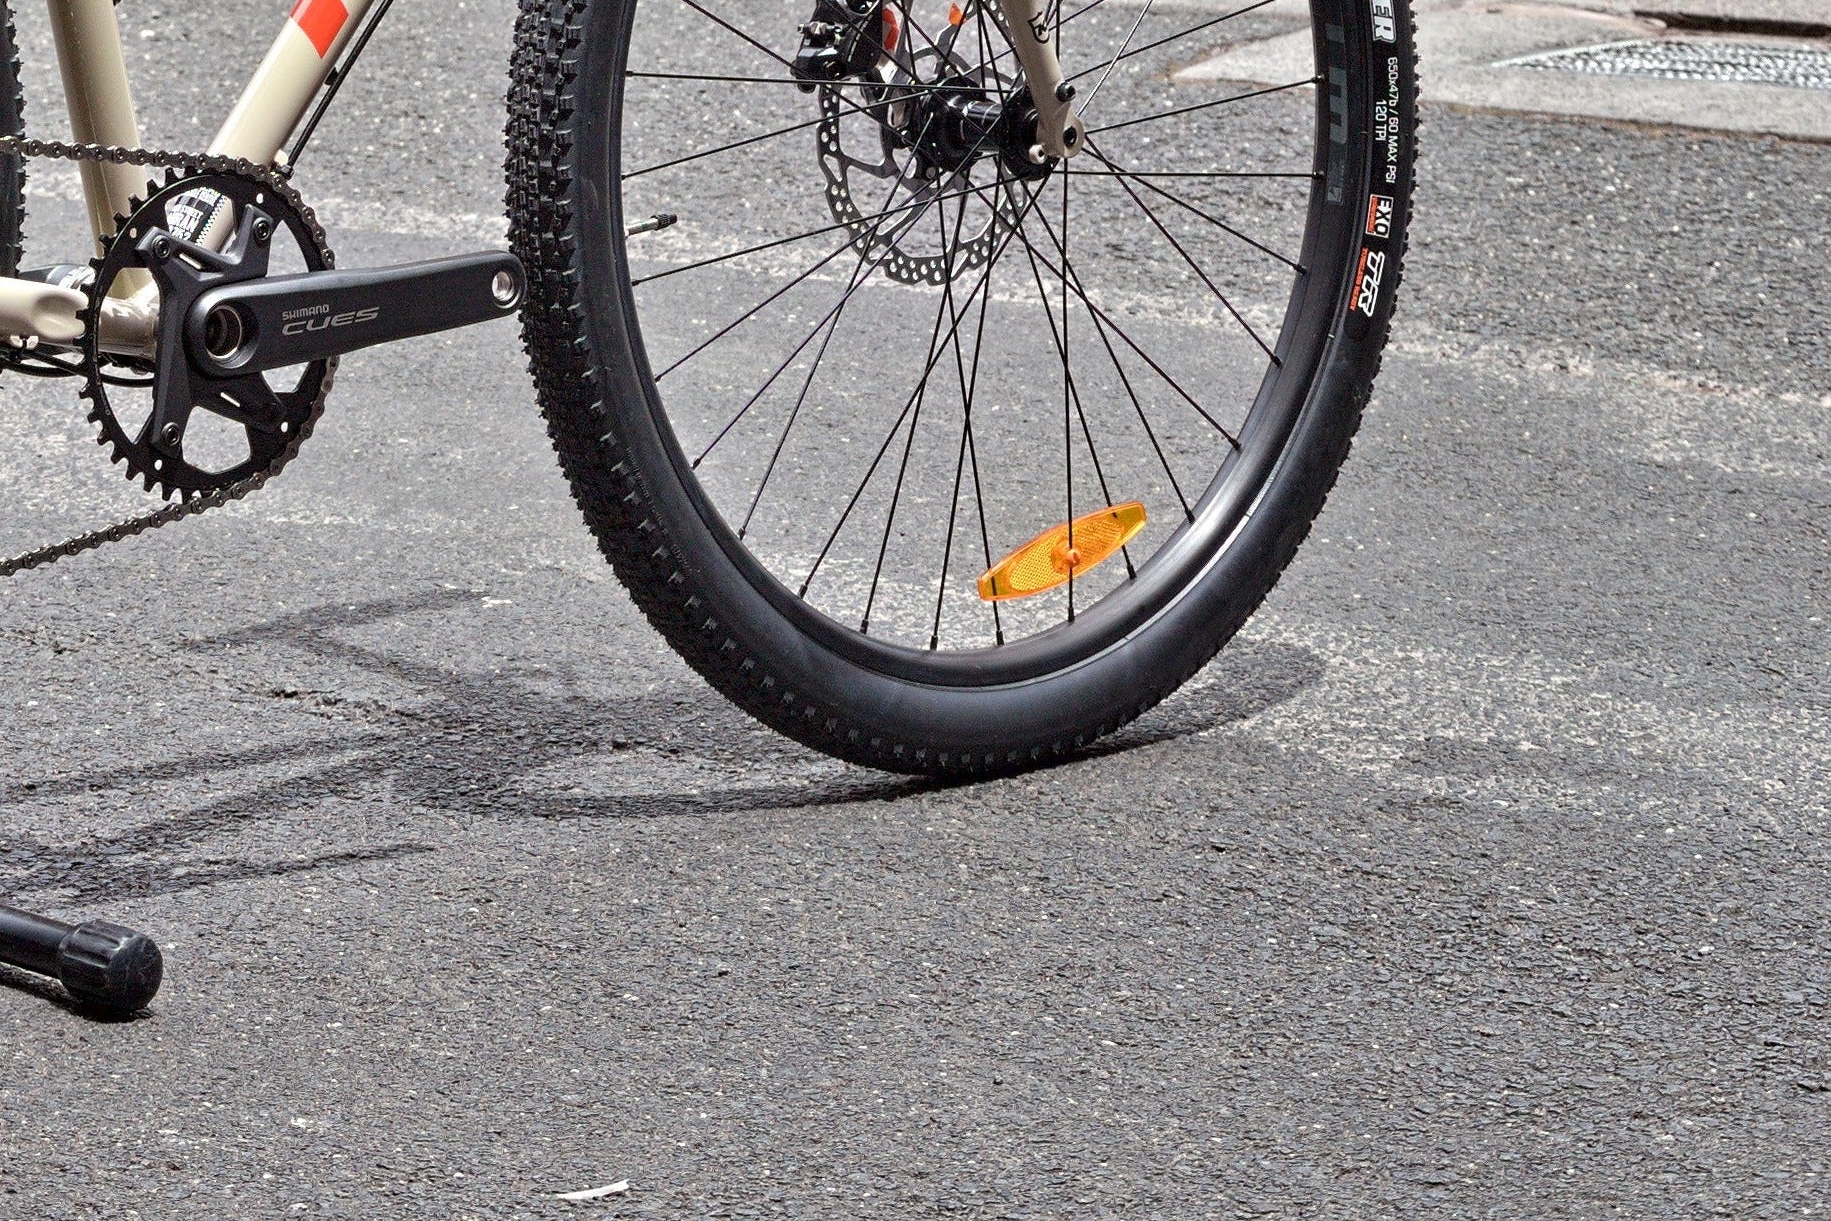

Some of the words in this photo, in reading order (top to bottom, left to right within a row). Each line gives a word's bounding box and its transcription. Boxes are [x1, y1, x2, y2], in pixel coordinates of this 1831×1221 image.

[1386, 56, 1399, 108] 650x47b
[1375, 100, 1387, 122] 120
[1375, 122, 1387, 142] TPI
[1388, 116, 1399, 133] 60
[1386, 135, 1399, 162] MAX
[1384, 162, 1399, 184] PSI
[1375, 196, 1393, 237] EXO
[1357, 250, 1386, 318] TR
[281, 306, 380, 336] CUES
[282, 303, 330, 321] SHIMANO
